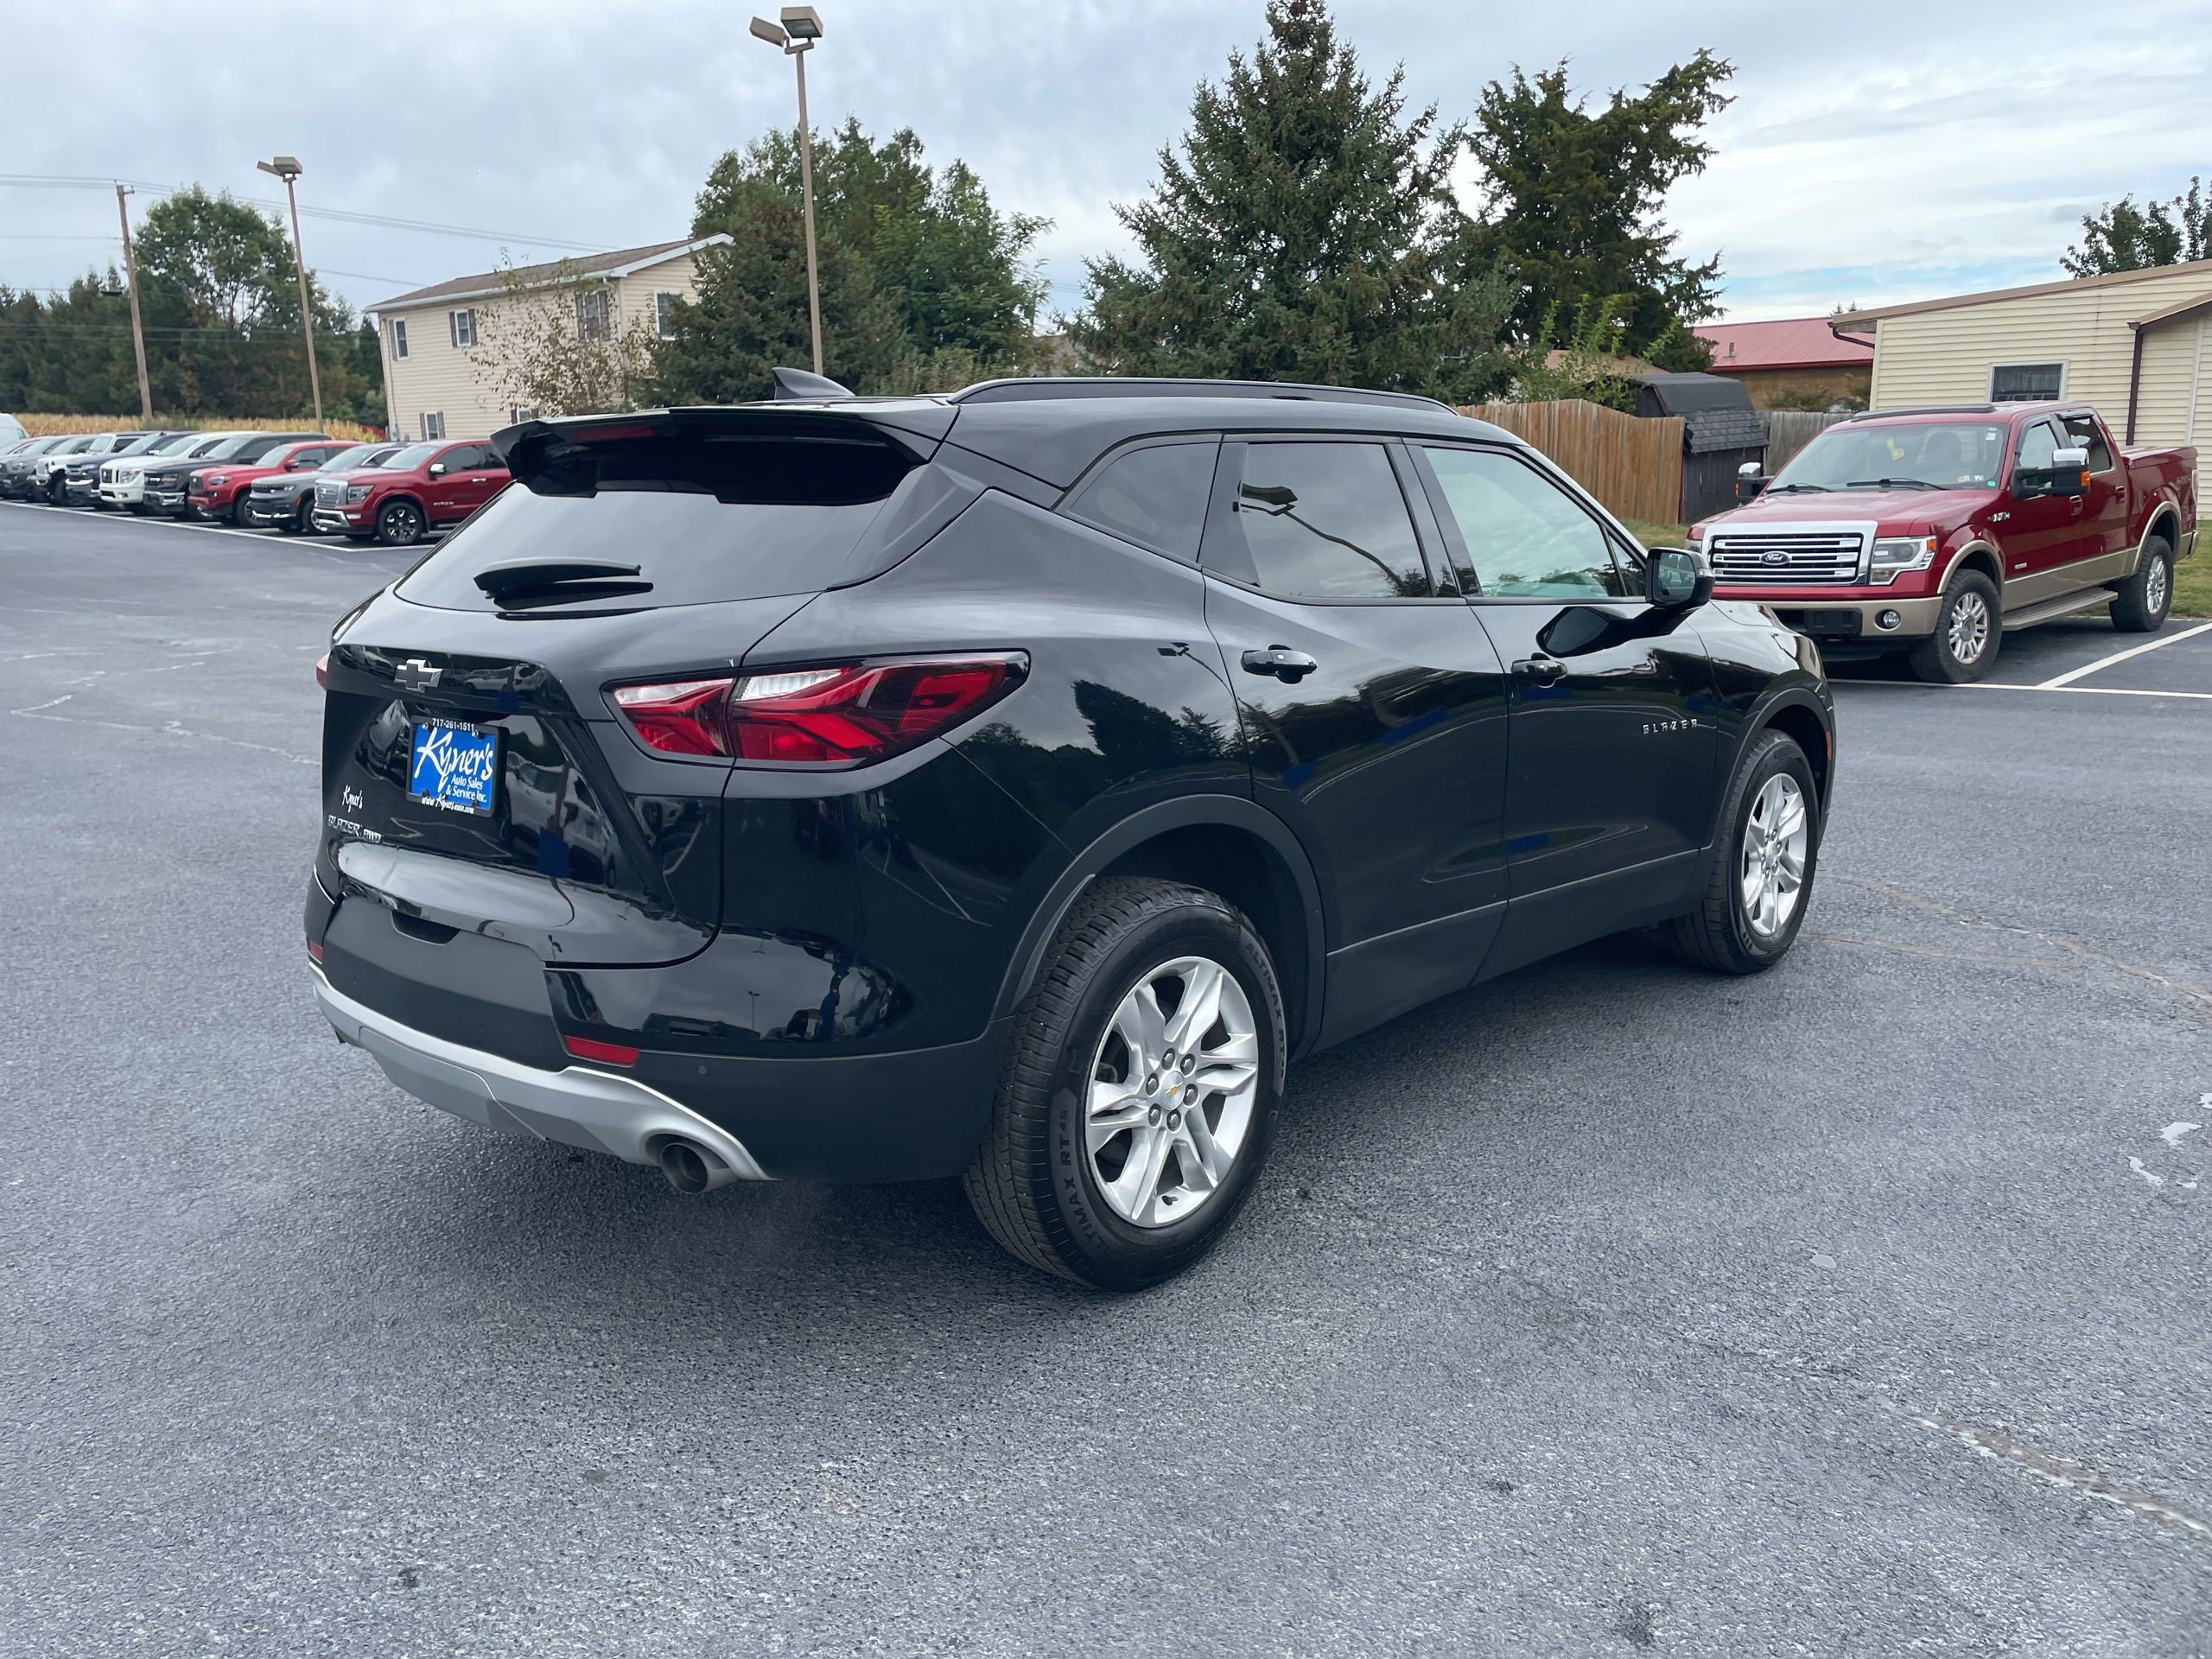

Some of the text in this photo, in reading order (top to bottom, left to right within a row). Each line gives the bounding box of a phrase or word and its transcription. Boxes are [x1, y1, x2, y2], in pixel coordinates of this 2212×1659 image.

[432, 718, 474, 732] 717-261-1511
[1643, 719, 1698, 734] BLAZER
[414, 727, 493, 793] Kyner's
[451, 774, 483, 791] Auto Sales
[445, 784, 487, 804] & Service Inc.
[328, 815, 382, 844] BLAZER AWD
[1244, 943, 1282, 1020] ALTIMAX
